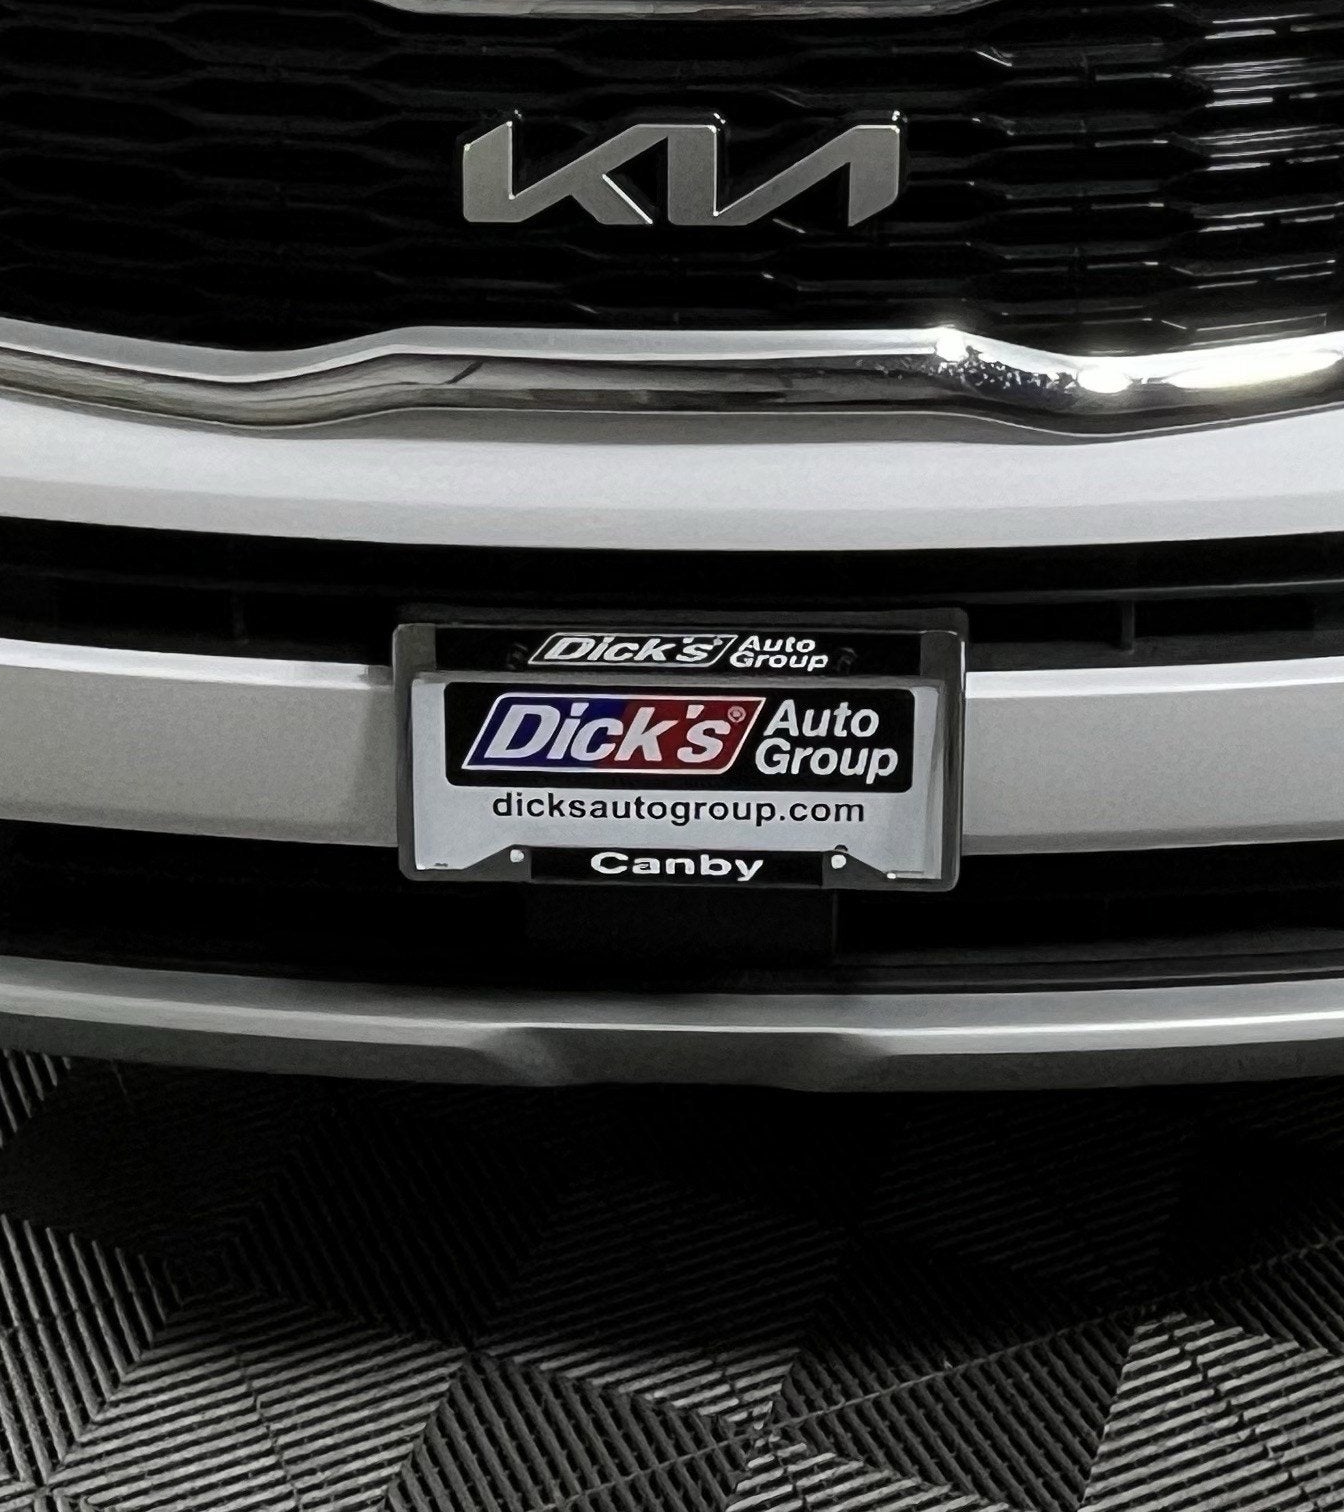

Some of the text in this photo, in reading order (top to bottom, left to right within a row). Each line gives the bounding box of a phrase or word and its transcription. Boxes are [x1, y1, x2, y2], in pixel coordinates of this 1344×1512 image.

[463, 121, 900, 227] KIA
[544, 635, 724, 663] Dick's
[729, 650, 829, 672] Group
[736, 635, 816, 653] Auto
[483, 702, 733, 763] Dick's
[762, 699, 880, 739] Auto
[754, 737, 900, 784] Group
[492, 791, 866, 828] dicksautogroup.com
[589, 850, 765, 880] Canby
